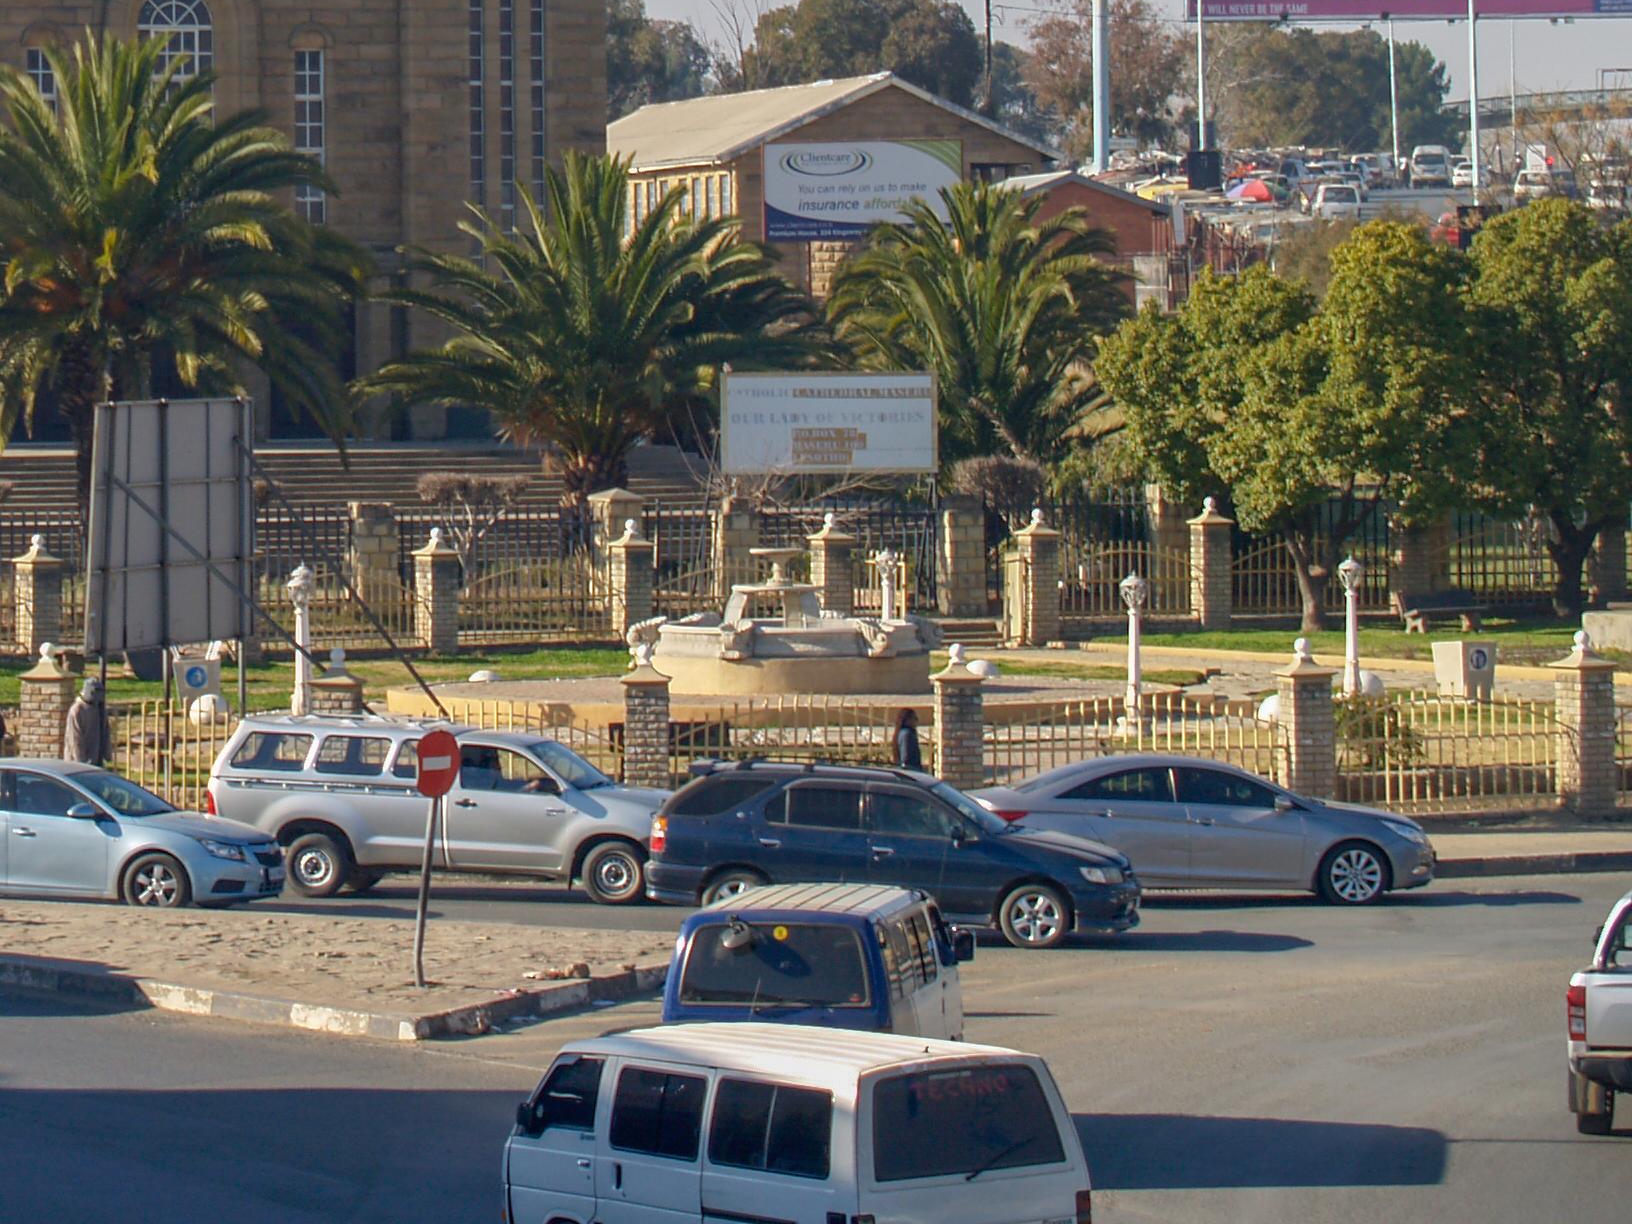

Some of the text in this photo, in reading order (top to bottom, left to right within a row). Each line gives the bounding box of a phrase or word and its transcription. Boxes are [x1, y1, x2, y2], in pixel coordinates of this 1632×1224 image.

[1207, 3, 1227, 14] WILL
[1229, 3, 1255, 14] NEVER
[800, 152, 851, 163] Clientcare
[798, 182, 927, 195] You can rely on us to make
[798, 199, 859, 211] insurance
[732, 412, 765, 424] OUR
[770, 412, 809, 424] LADY
[841, 411, 925, 423] VICTORIES
[909, 1074, 1009, 1099] TECHNO
